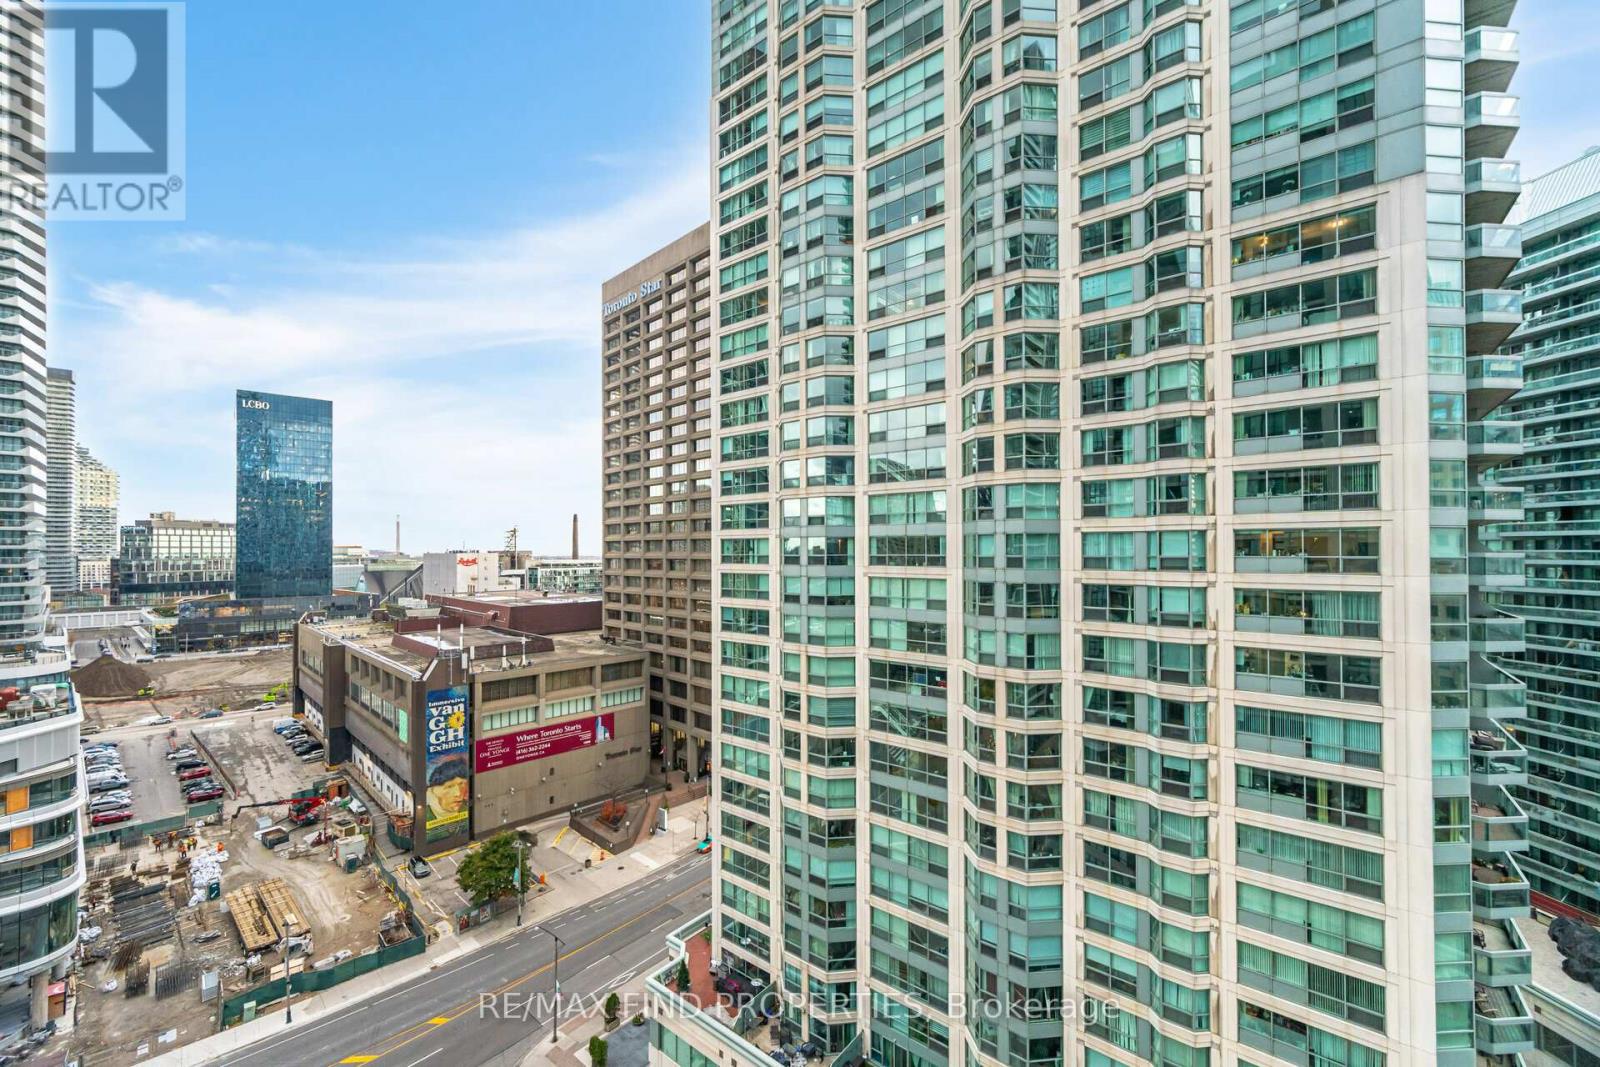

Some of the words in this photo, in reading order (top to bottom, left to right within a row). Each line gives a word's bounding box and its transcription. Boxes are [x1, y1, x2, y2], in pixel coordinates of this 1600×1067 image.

[242, 399, 270, 410] LCBO
[429, 703, 465, 717] van
[429, 727, 465, 744] GH
[516, 732, 539, 742] Where
[540, 728, 563, 738] Toronto
[564, 724, 582, 732] Starts
[429, 740, 465, 753] Exhibit
